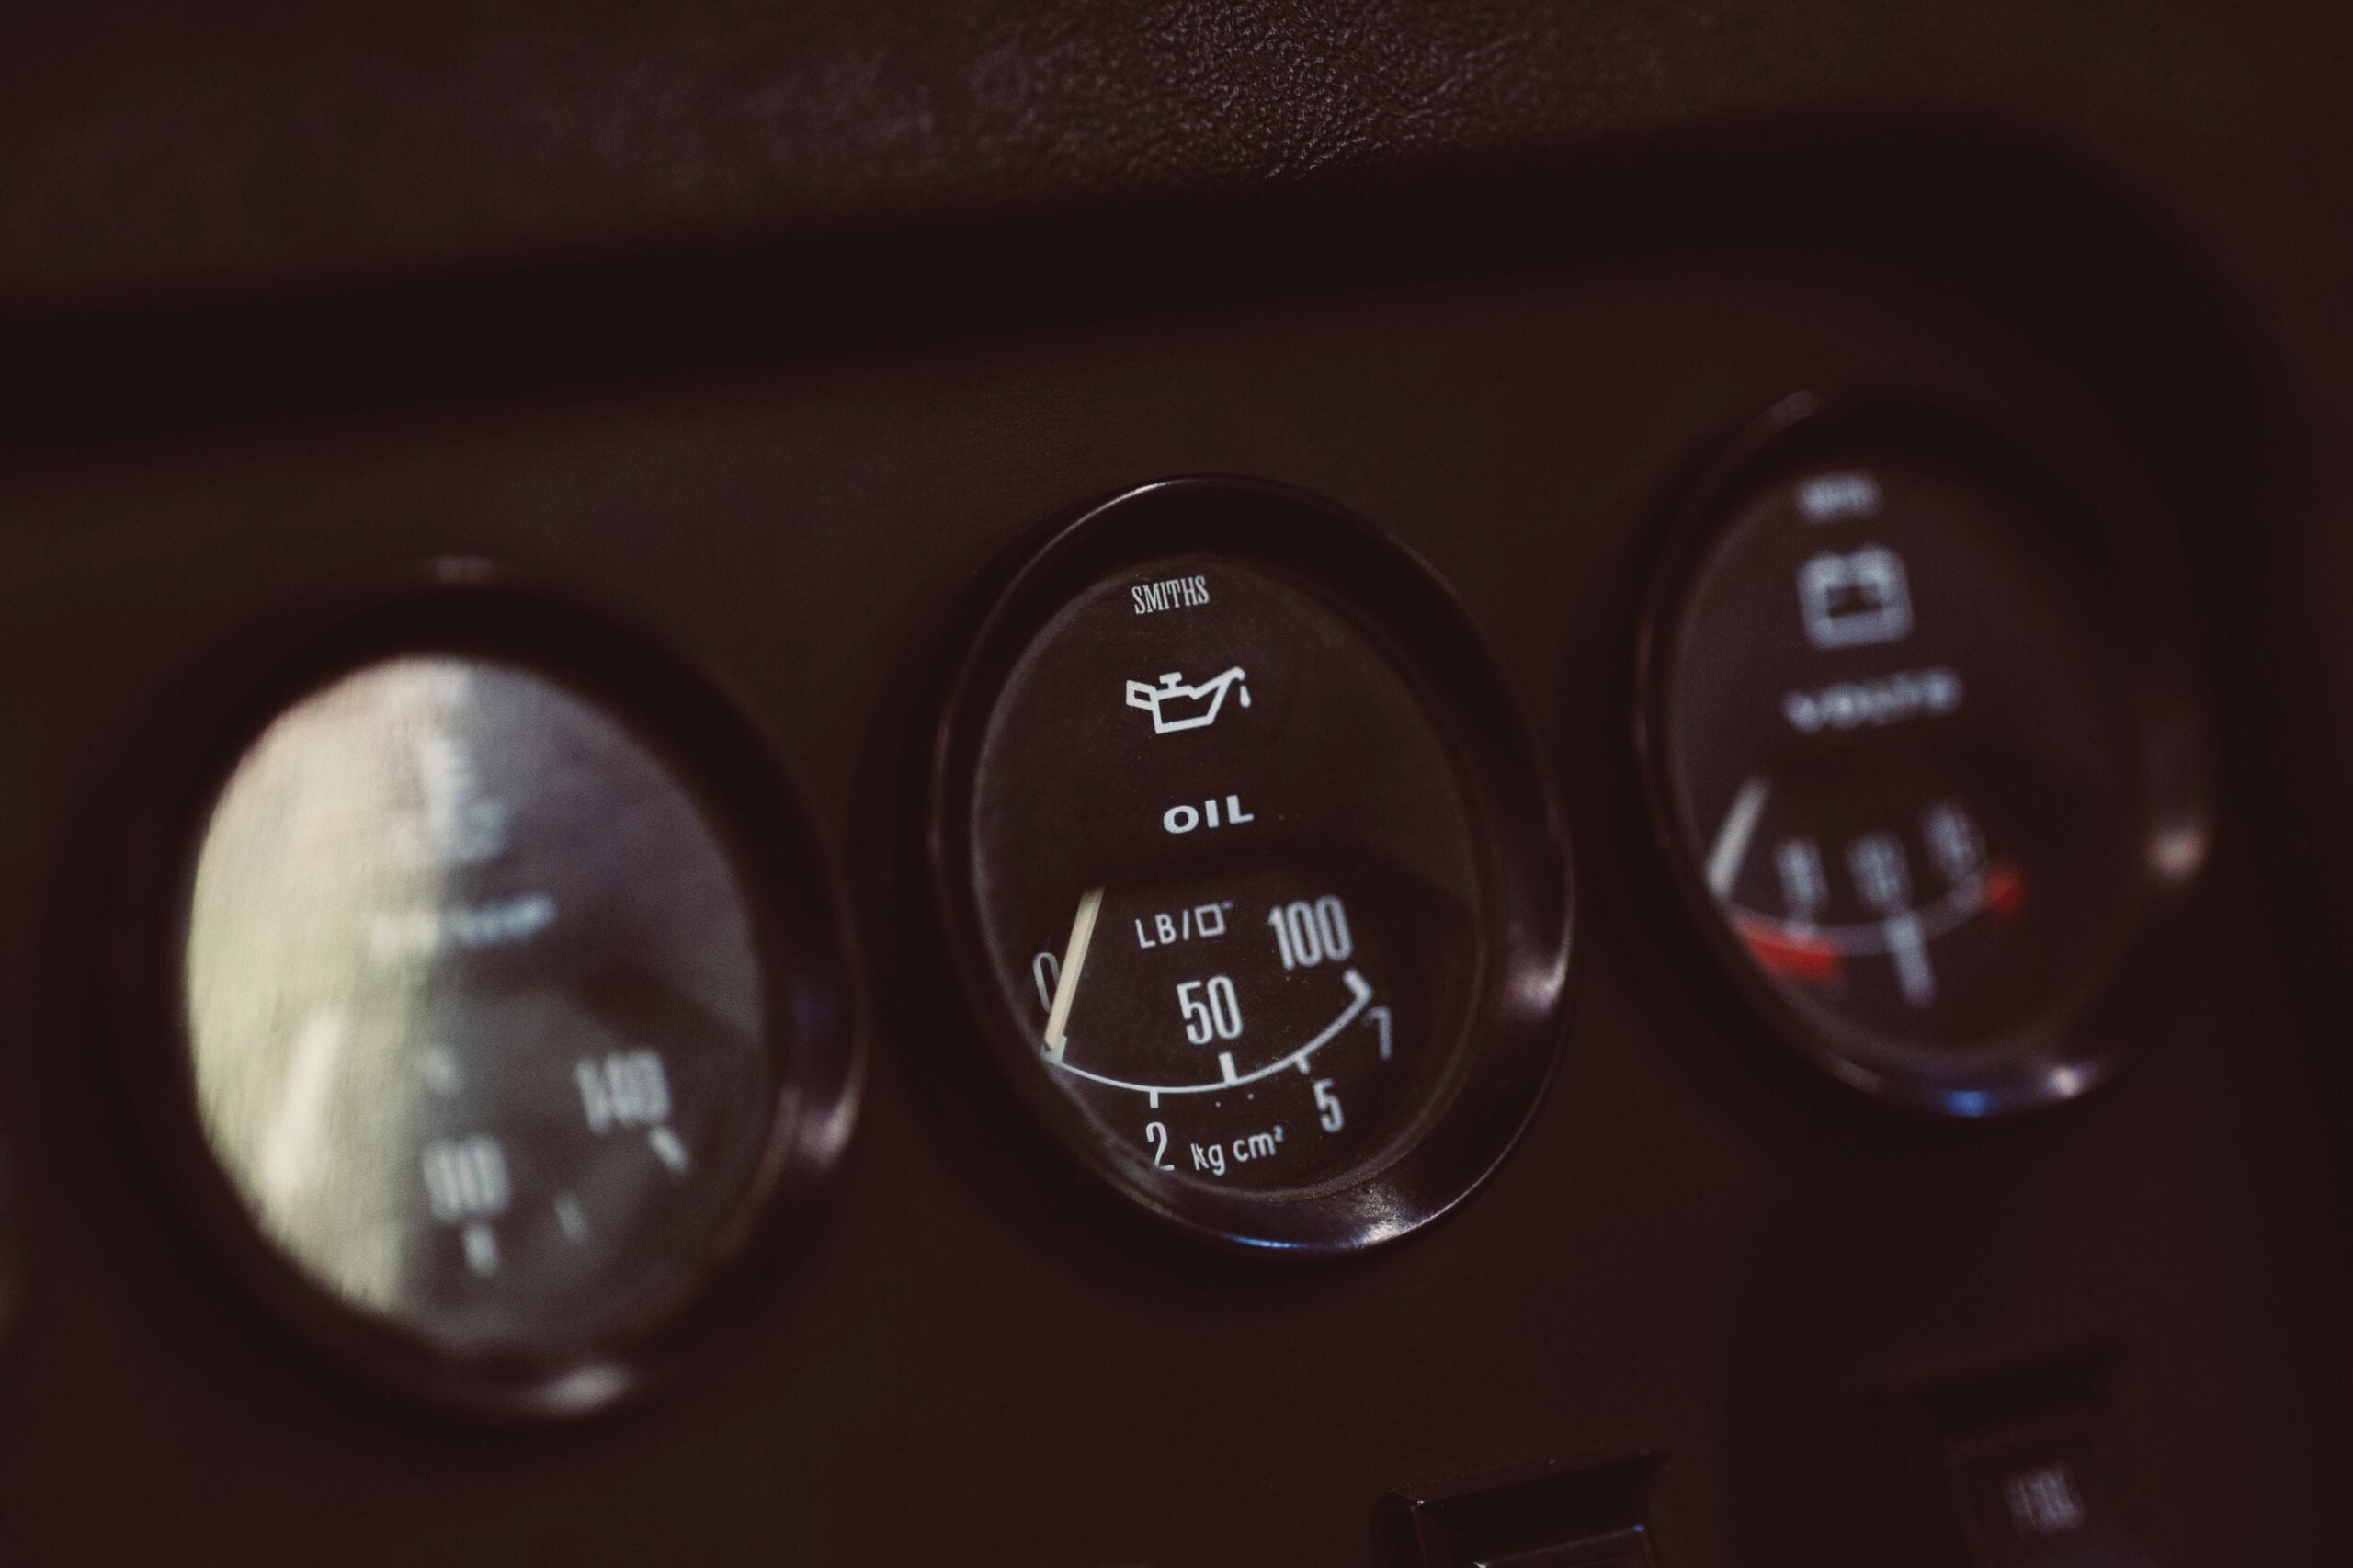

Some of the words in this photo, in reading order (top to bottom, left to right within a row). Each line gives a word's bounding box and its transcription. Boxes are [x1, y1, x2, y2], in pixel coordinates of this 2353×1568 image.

[1131, 575, 1210, 615] SMITHS
[1163, 794, 1254, 834] OIL
[1267, 895, 1352, 971] 100
[1176, 974, 1244, 1045] 50
[1313, 1077, 1345, 1133] 5
[1145, 1121, 1175, 1172] 2
[1190, 1142, 1226, 1176] kg
